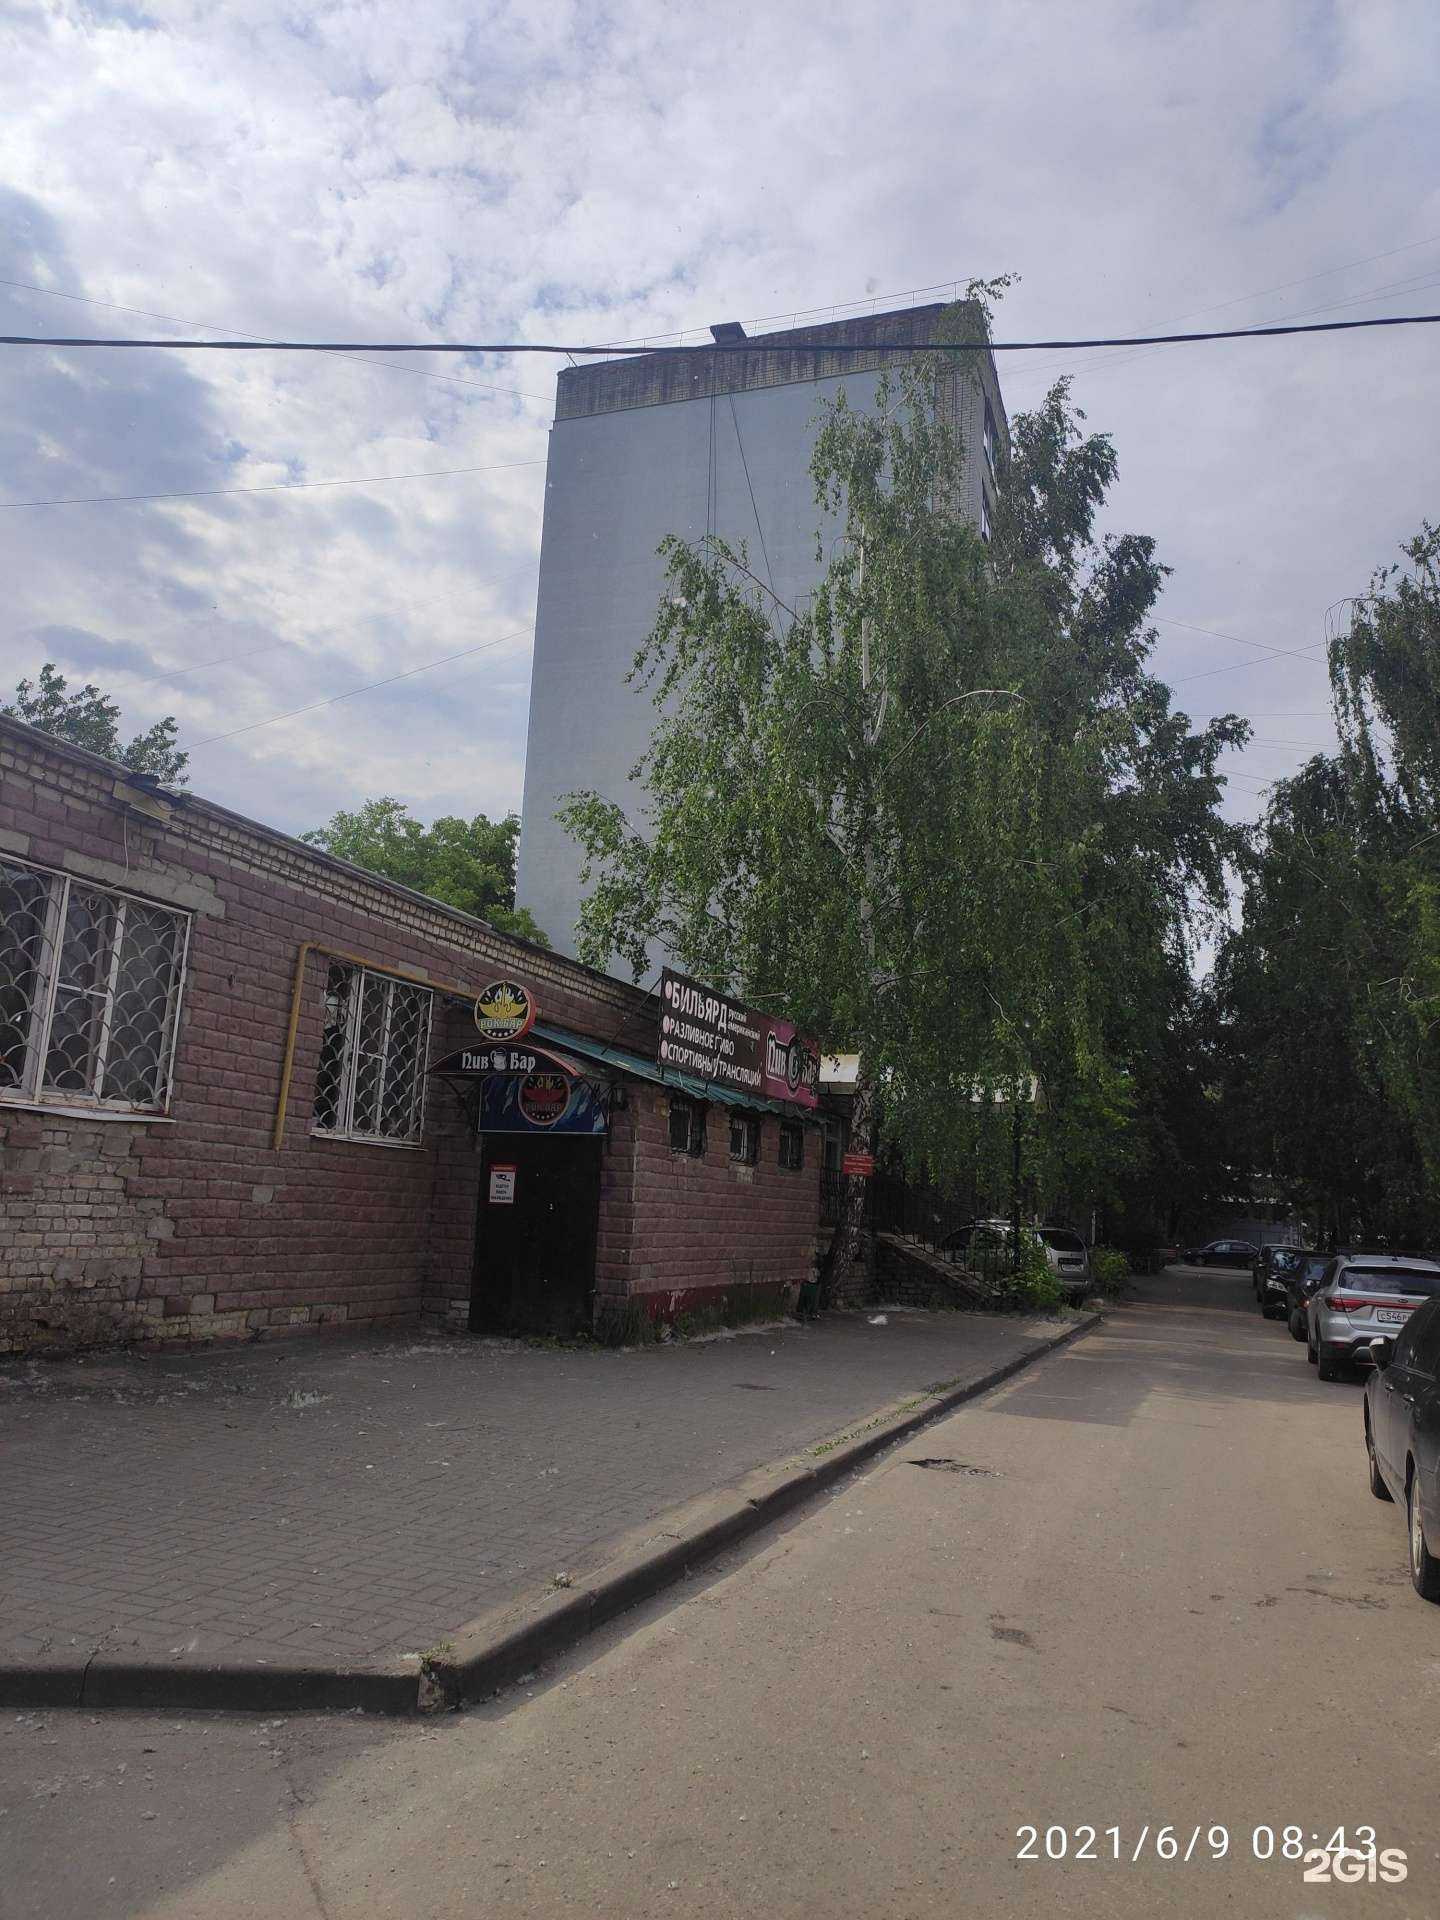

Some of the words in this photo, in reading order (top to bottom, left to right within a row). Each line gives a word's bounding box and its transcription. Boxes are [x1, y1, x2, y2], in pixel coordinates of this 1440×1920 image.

[671, 981, 728, 1034] БИЛЬЯРД
[669, 1019, 715, 1050] РАЗЛИВНОЕ
[462, 1052, 489, 1070] Пив
[510, 1052, 536, 1074] Бар
